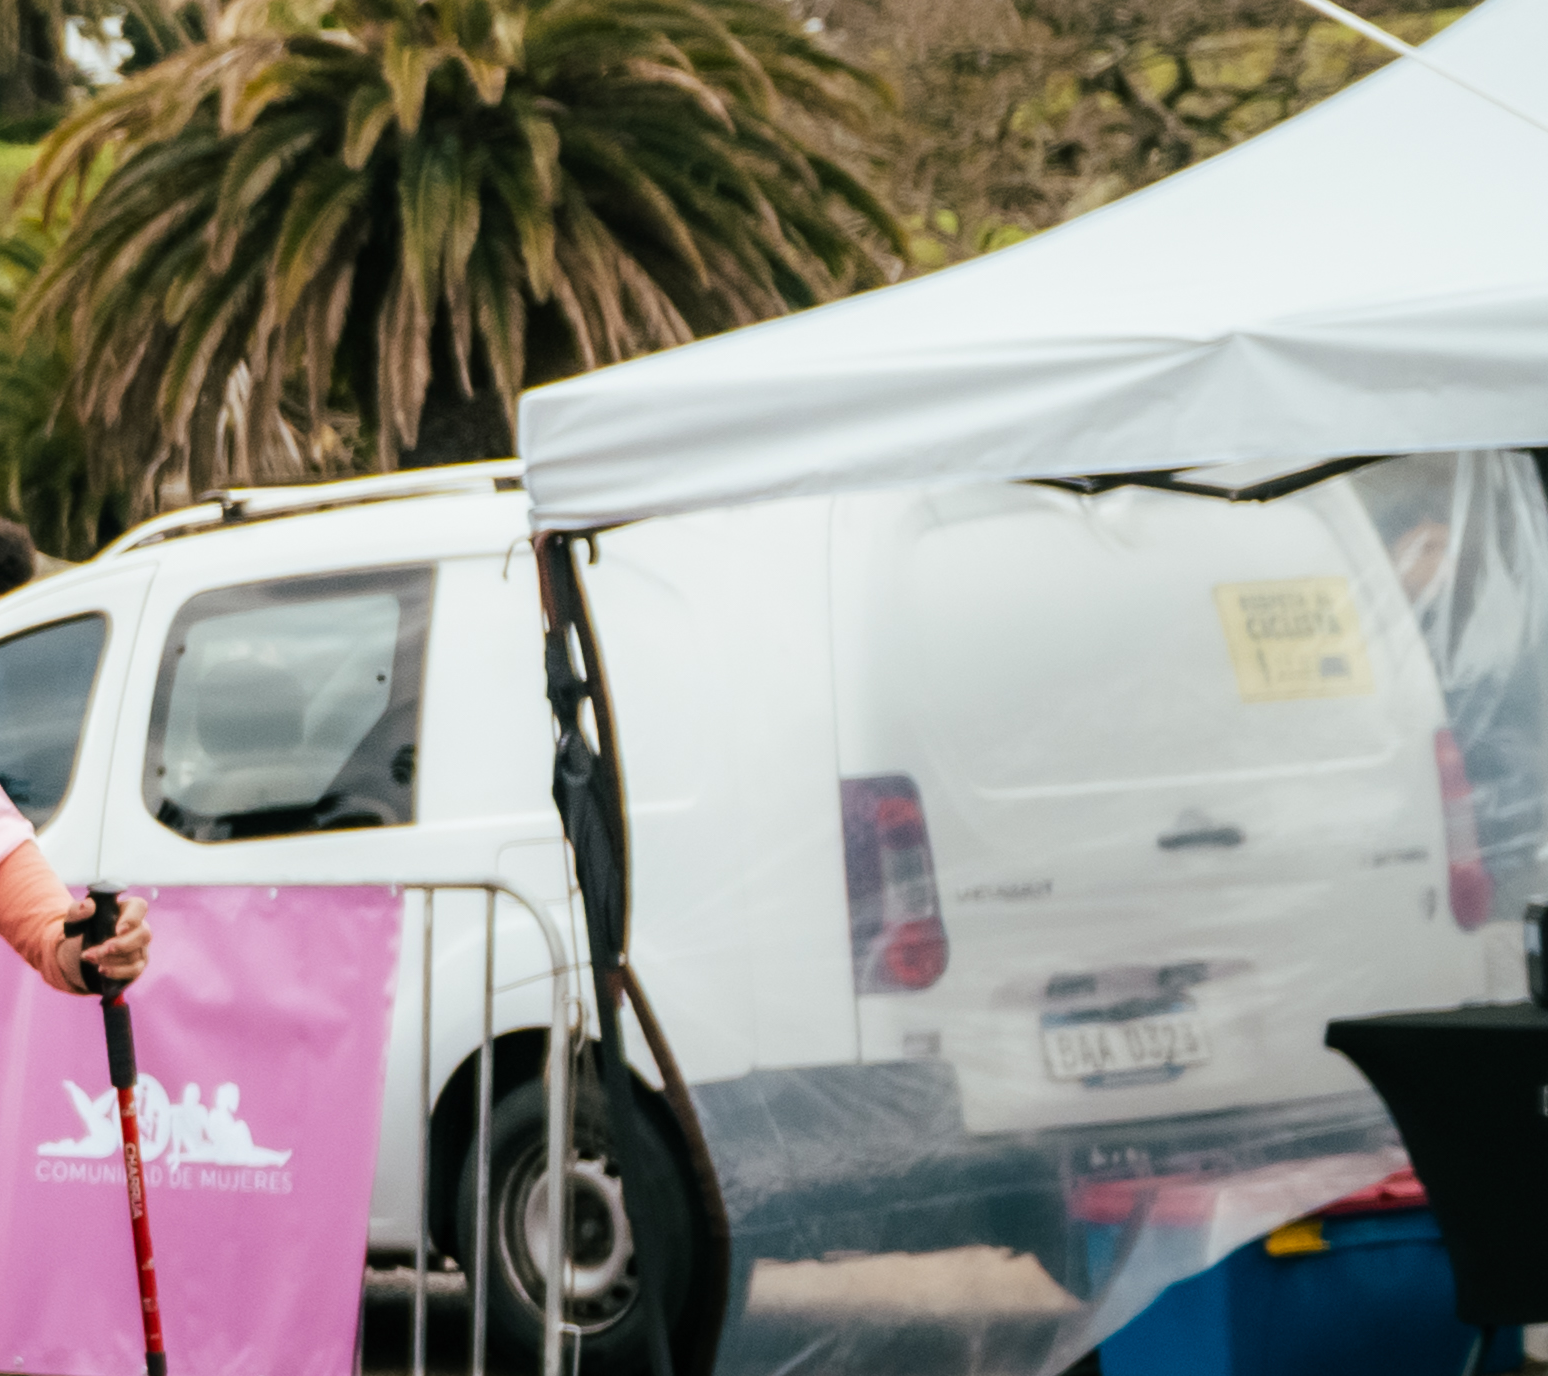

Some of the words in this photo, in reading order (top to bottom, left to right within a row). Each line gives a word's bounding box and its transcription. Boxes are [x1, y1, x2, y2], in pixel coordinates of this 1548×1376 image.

[35, 1160, 163, 1188] COMUNIAD
[169, 1168, 195, 1190] DE
[201, 1170, 294, 1195] MUJERES
[125, 1142, 144, 1220] CHARRUA
